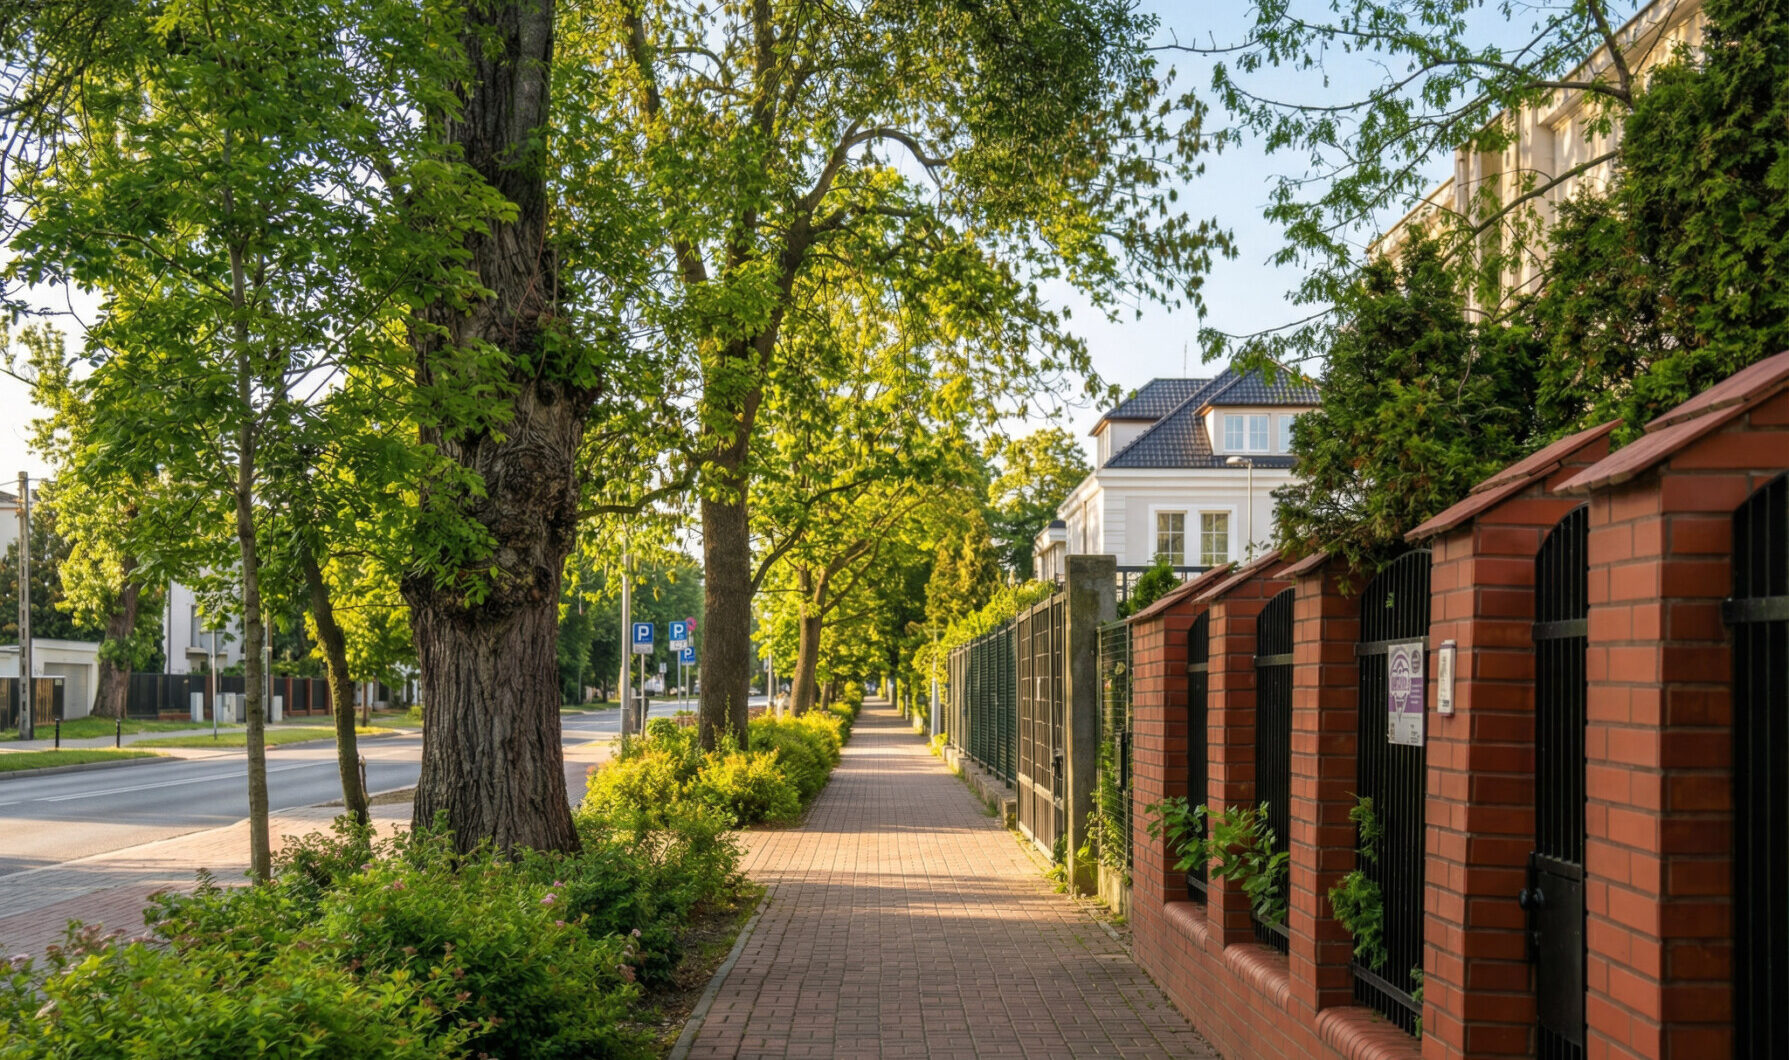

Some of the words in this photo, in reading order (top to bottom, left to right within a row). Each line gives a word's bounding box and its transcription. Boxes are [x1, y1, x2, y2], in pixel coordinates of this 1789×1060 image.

[638, 626, 649, 641] P
[674, 624, 684, 639] P
[684, 648, 692, 659] P
